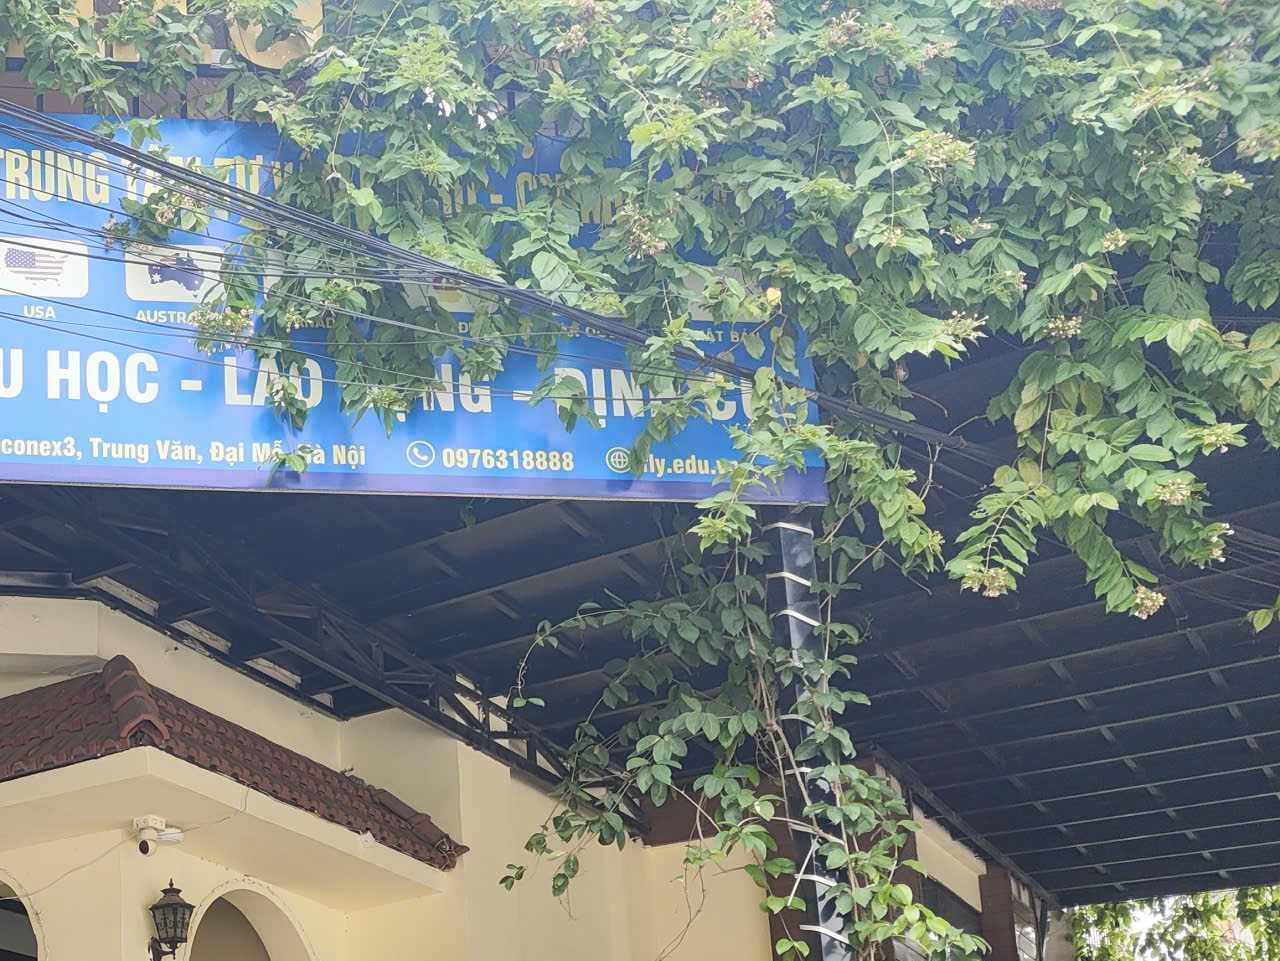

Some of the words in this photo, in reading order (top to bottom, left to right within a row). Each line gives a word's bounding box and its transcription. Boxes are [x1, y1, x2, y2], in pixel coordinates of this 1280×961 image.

[23, 304, 57, 320] USA
[45, 350, 160, 413] HỌC
[88, 436, 150, 464] Trung
[155, 438, 204, 465] Văn,
[209, 440, 245, 467] Đại
[332, 444, 367, 470] Nội
[442, 447, 575, 471] 0976318888
